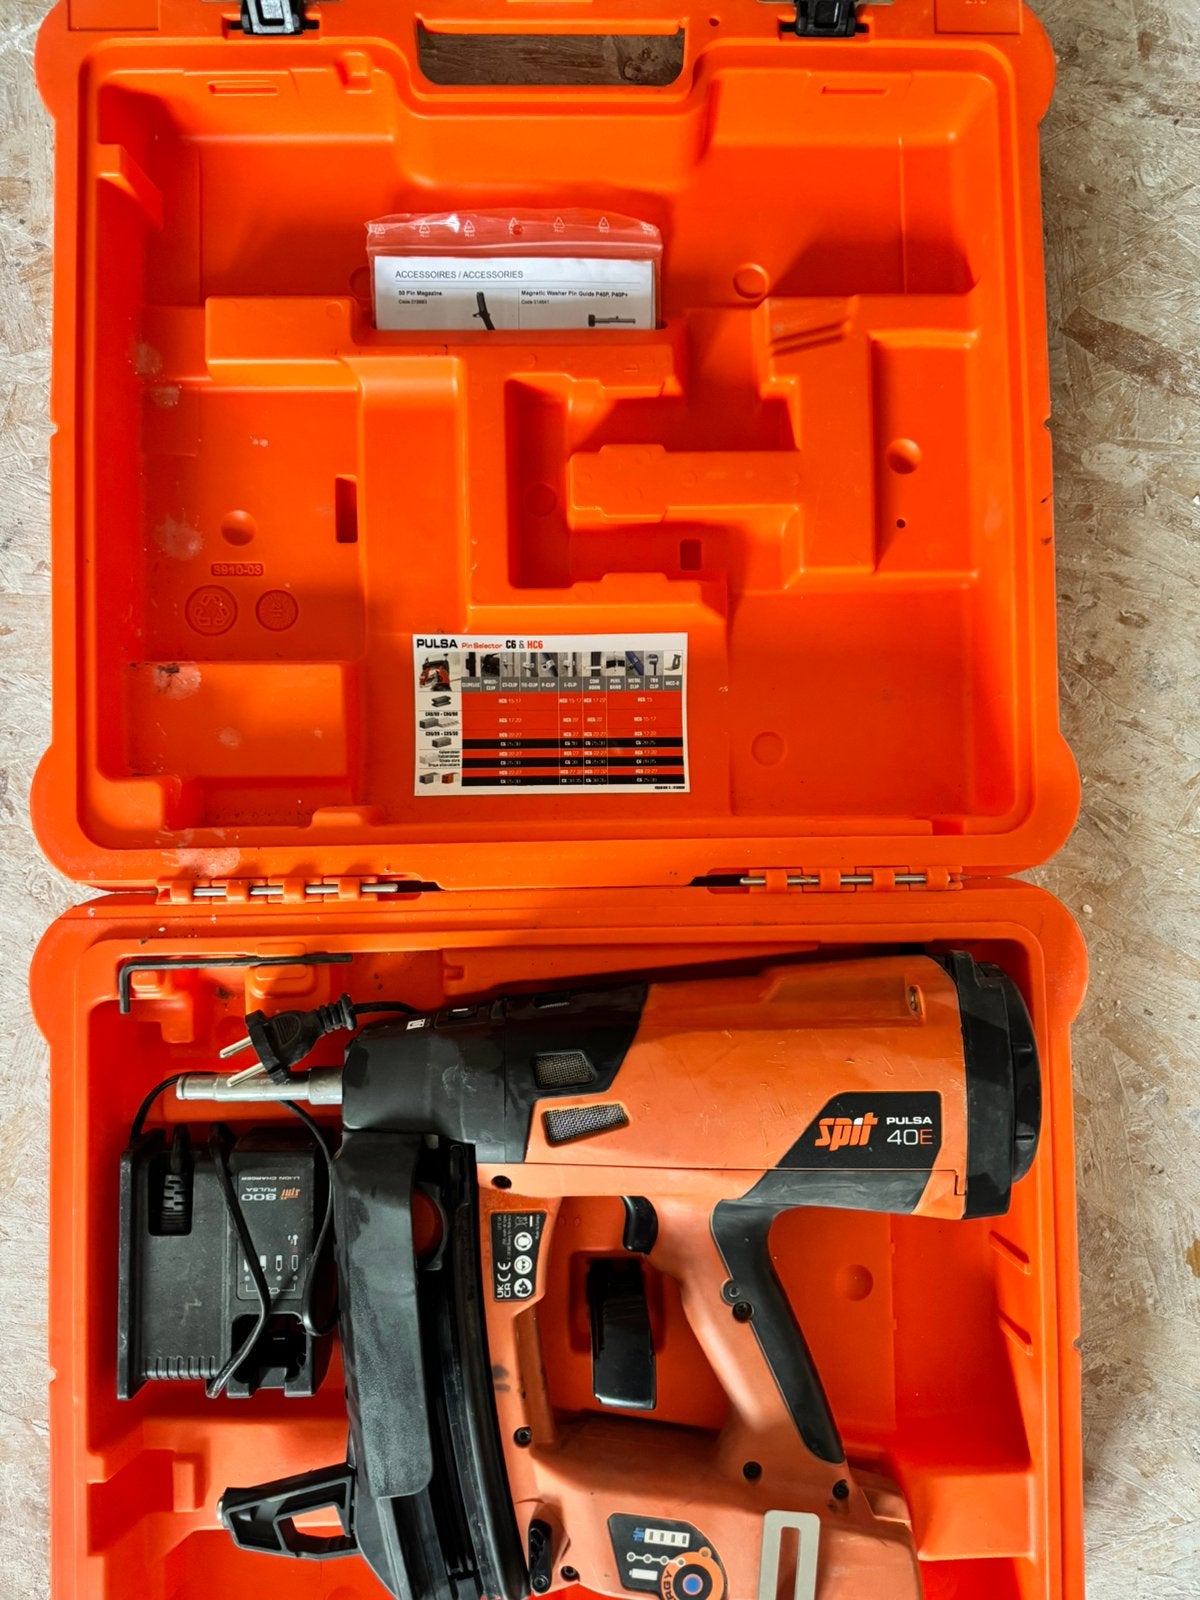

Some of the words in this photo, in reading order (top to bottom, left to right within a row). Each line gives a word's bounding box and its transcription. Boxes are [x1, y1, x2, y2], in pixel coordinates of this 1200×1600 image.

[395, 270, 457, 279] ACCESSOIRES
[463, 270, 524, 279] ACCESSORIES
[416, 639, 458, 649] PULSA
[505, 640, 517, 649] C6
[518, 640, 525, 649] &
[527, 640, 543, 649] HC6
[886, 1116, 933, 1125] PULSA
[814, 1112, 878, 1151] spit
[886, 1129, 933, 1145] 40E
[241, 1193, 277, 1201] 800
